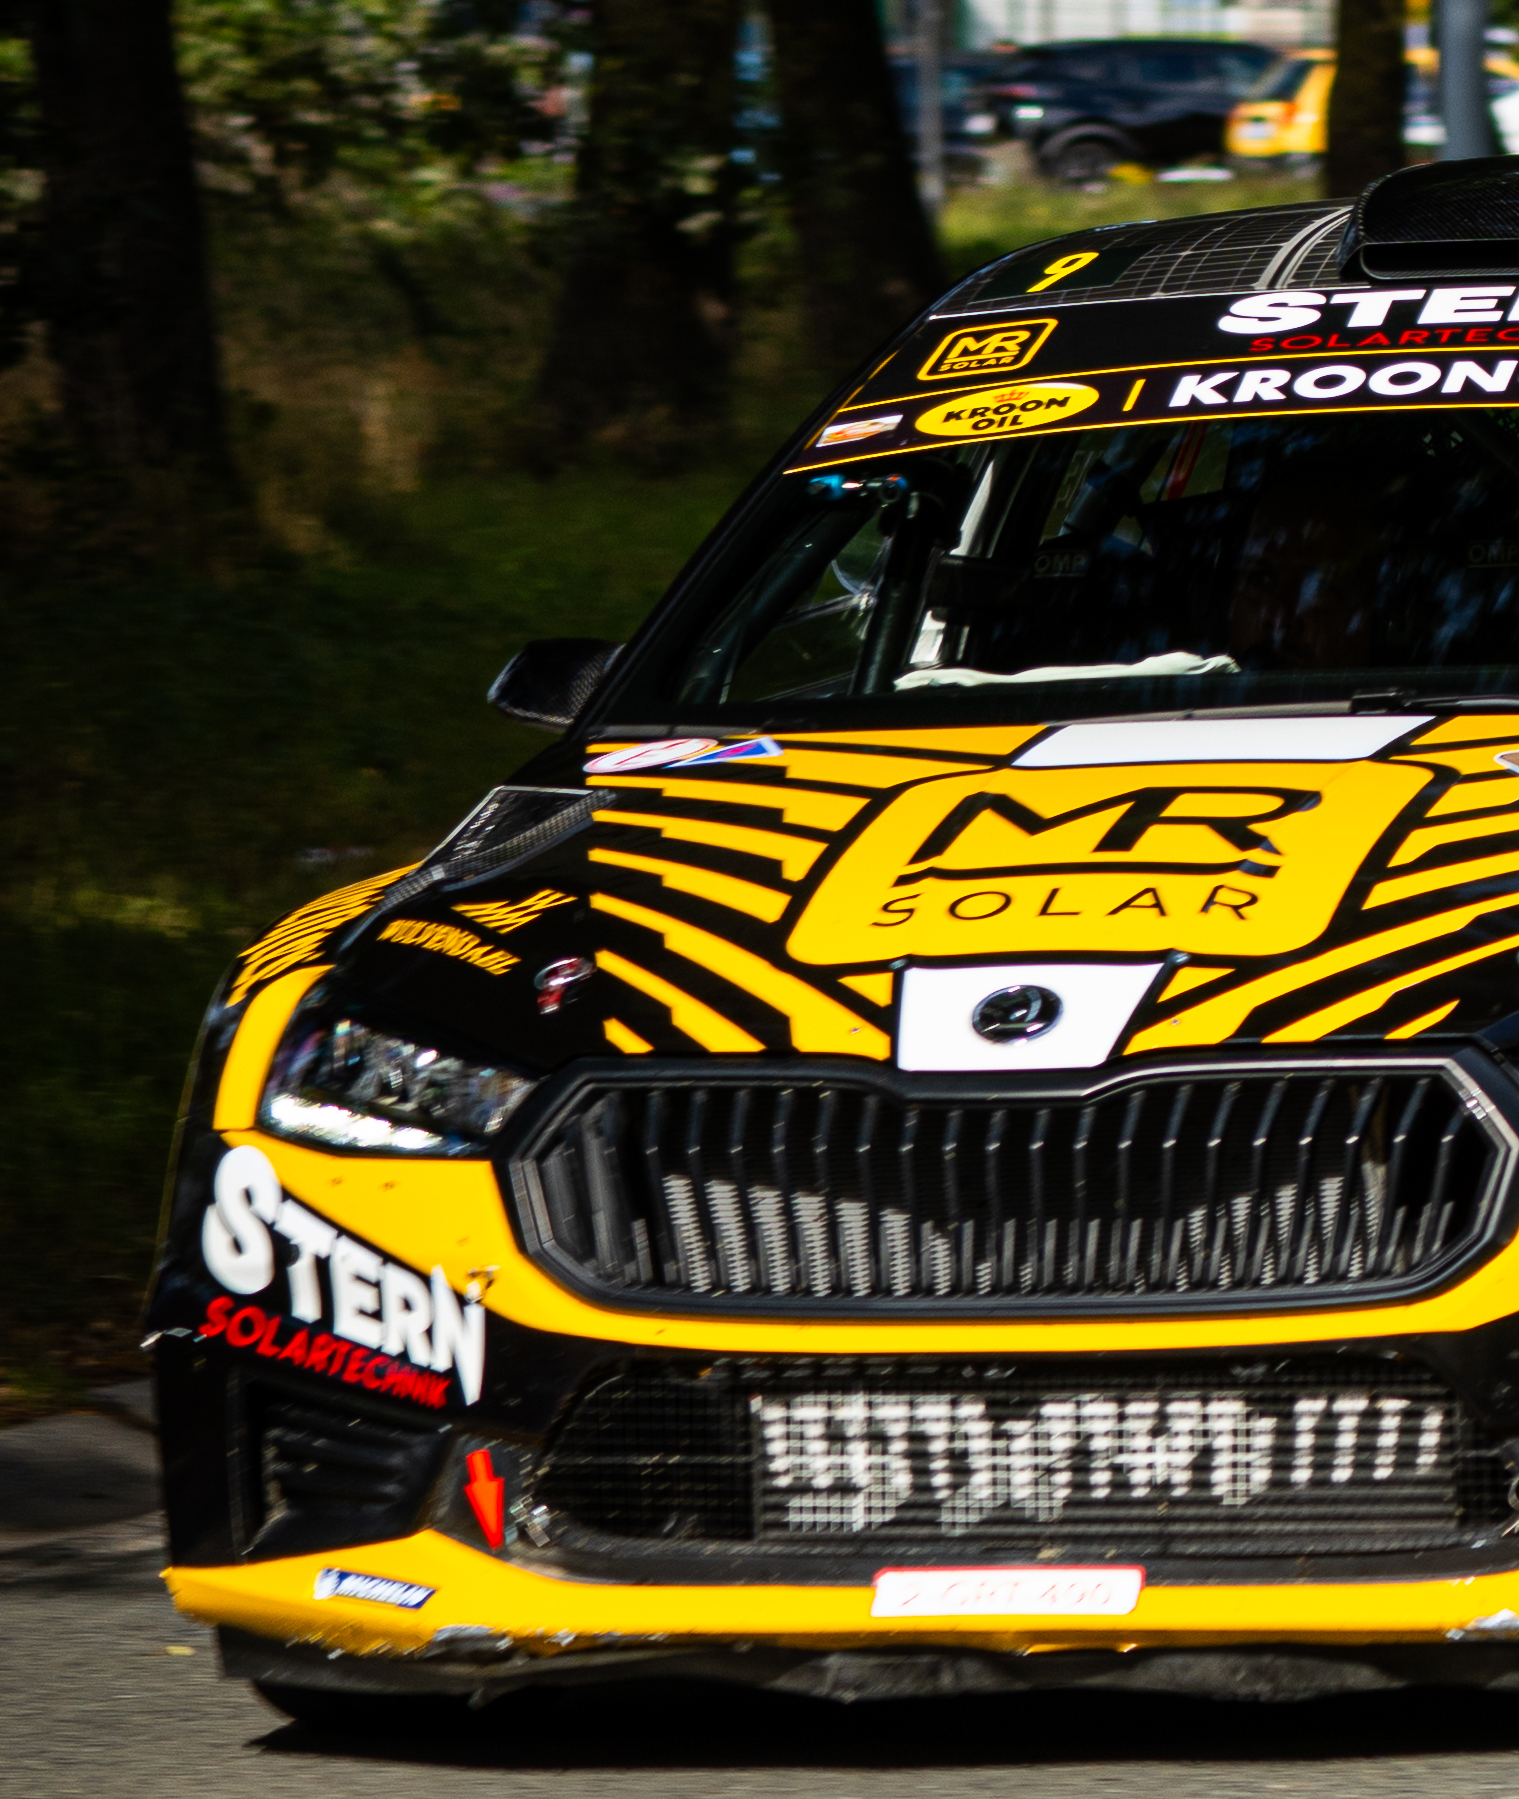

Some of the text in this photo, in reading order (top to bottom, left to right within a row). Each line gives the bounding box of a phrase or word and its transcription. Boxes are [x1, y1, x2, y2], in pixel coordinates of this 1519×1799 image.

[947, 330, 1031, 359] MR
[938, 356, 1014, 372] SOLAR
[942, 396, 1071, 423] KROON
[971, 414, 1023, 431] OIL
[905, 786, 1322, 867] MR
[868, 884, 1260, 927] SOLAR
[201, 1145, 486, 1406] STERN
[199, 1296, 452, 1410] SOLARTECHNIK
